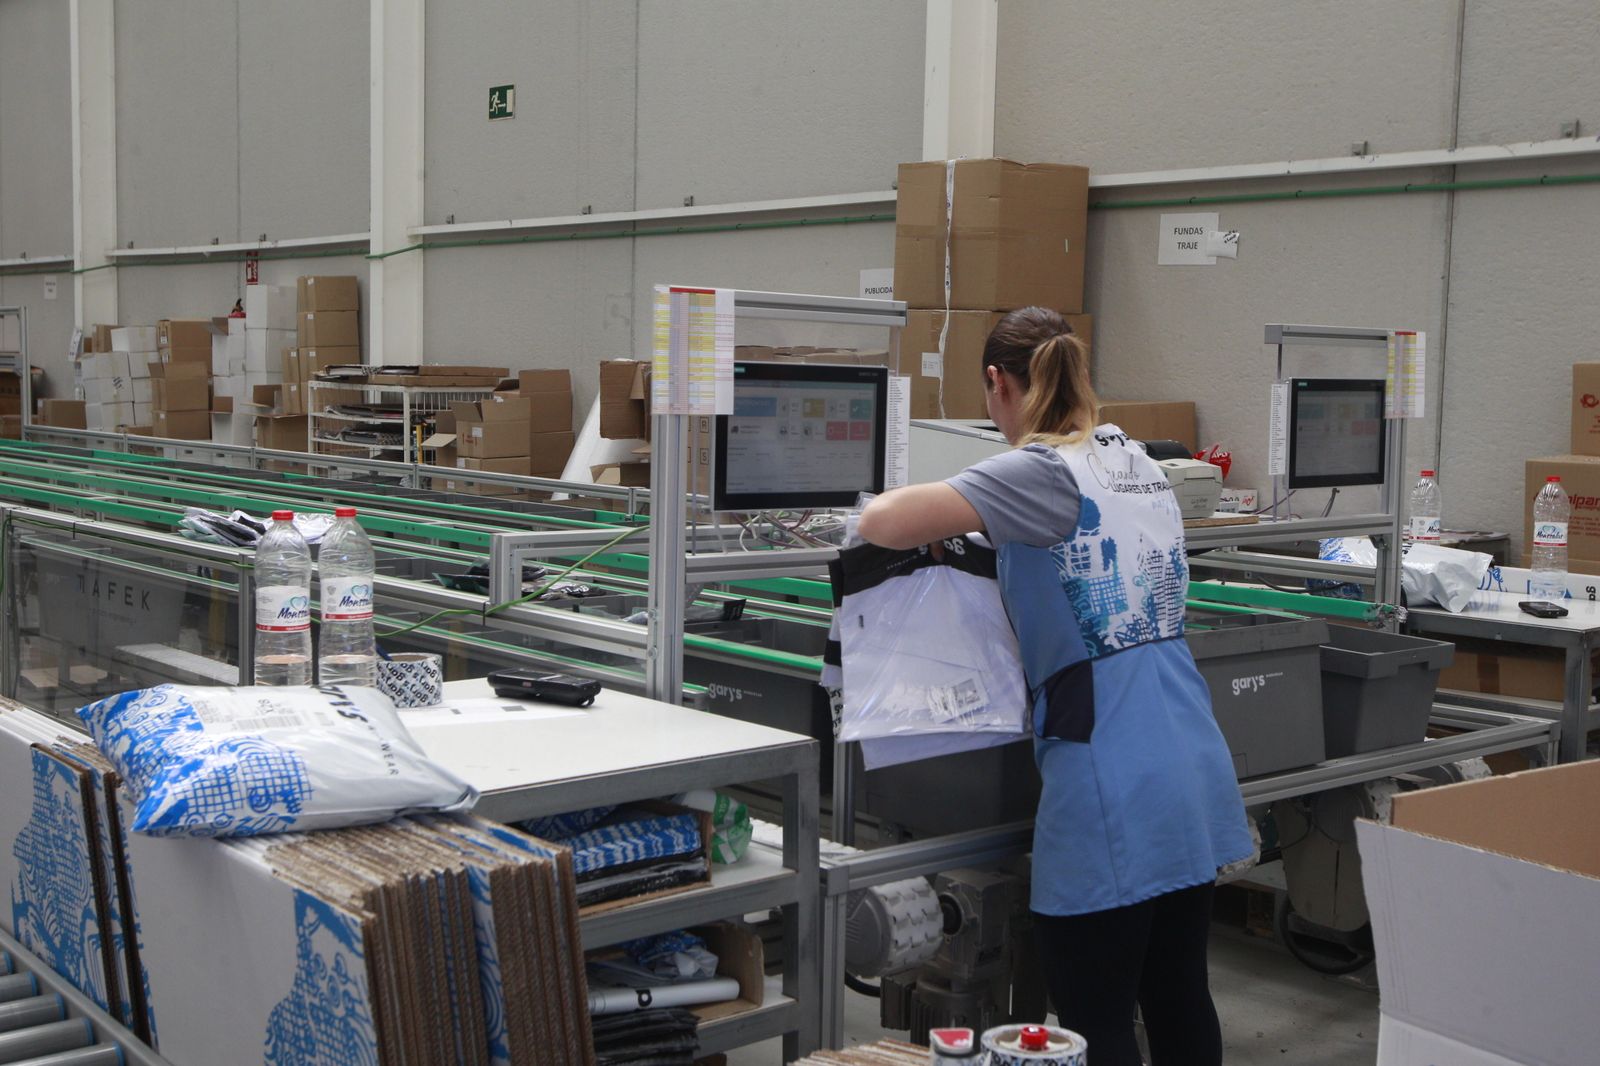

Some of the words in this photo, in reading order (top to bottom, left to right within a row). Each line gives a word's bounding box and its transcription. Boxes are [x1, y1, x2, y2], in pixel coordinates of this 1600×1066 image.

[1174, 227, 1203, 235] FUNDAS
[1111, 483, 1142, 494] LUGARES
[1141, 483, 1153, 494] DE
[708, 683, 742, 702] gary's
[1232, 675, 1265, 695] gary's
